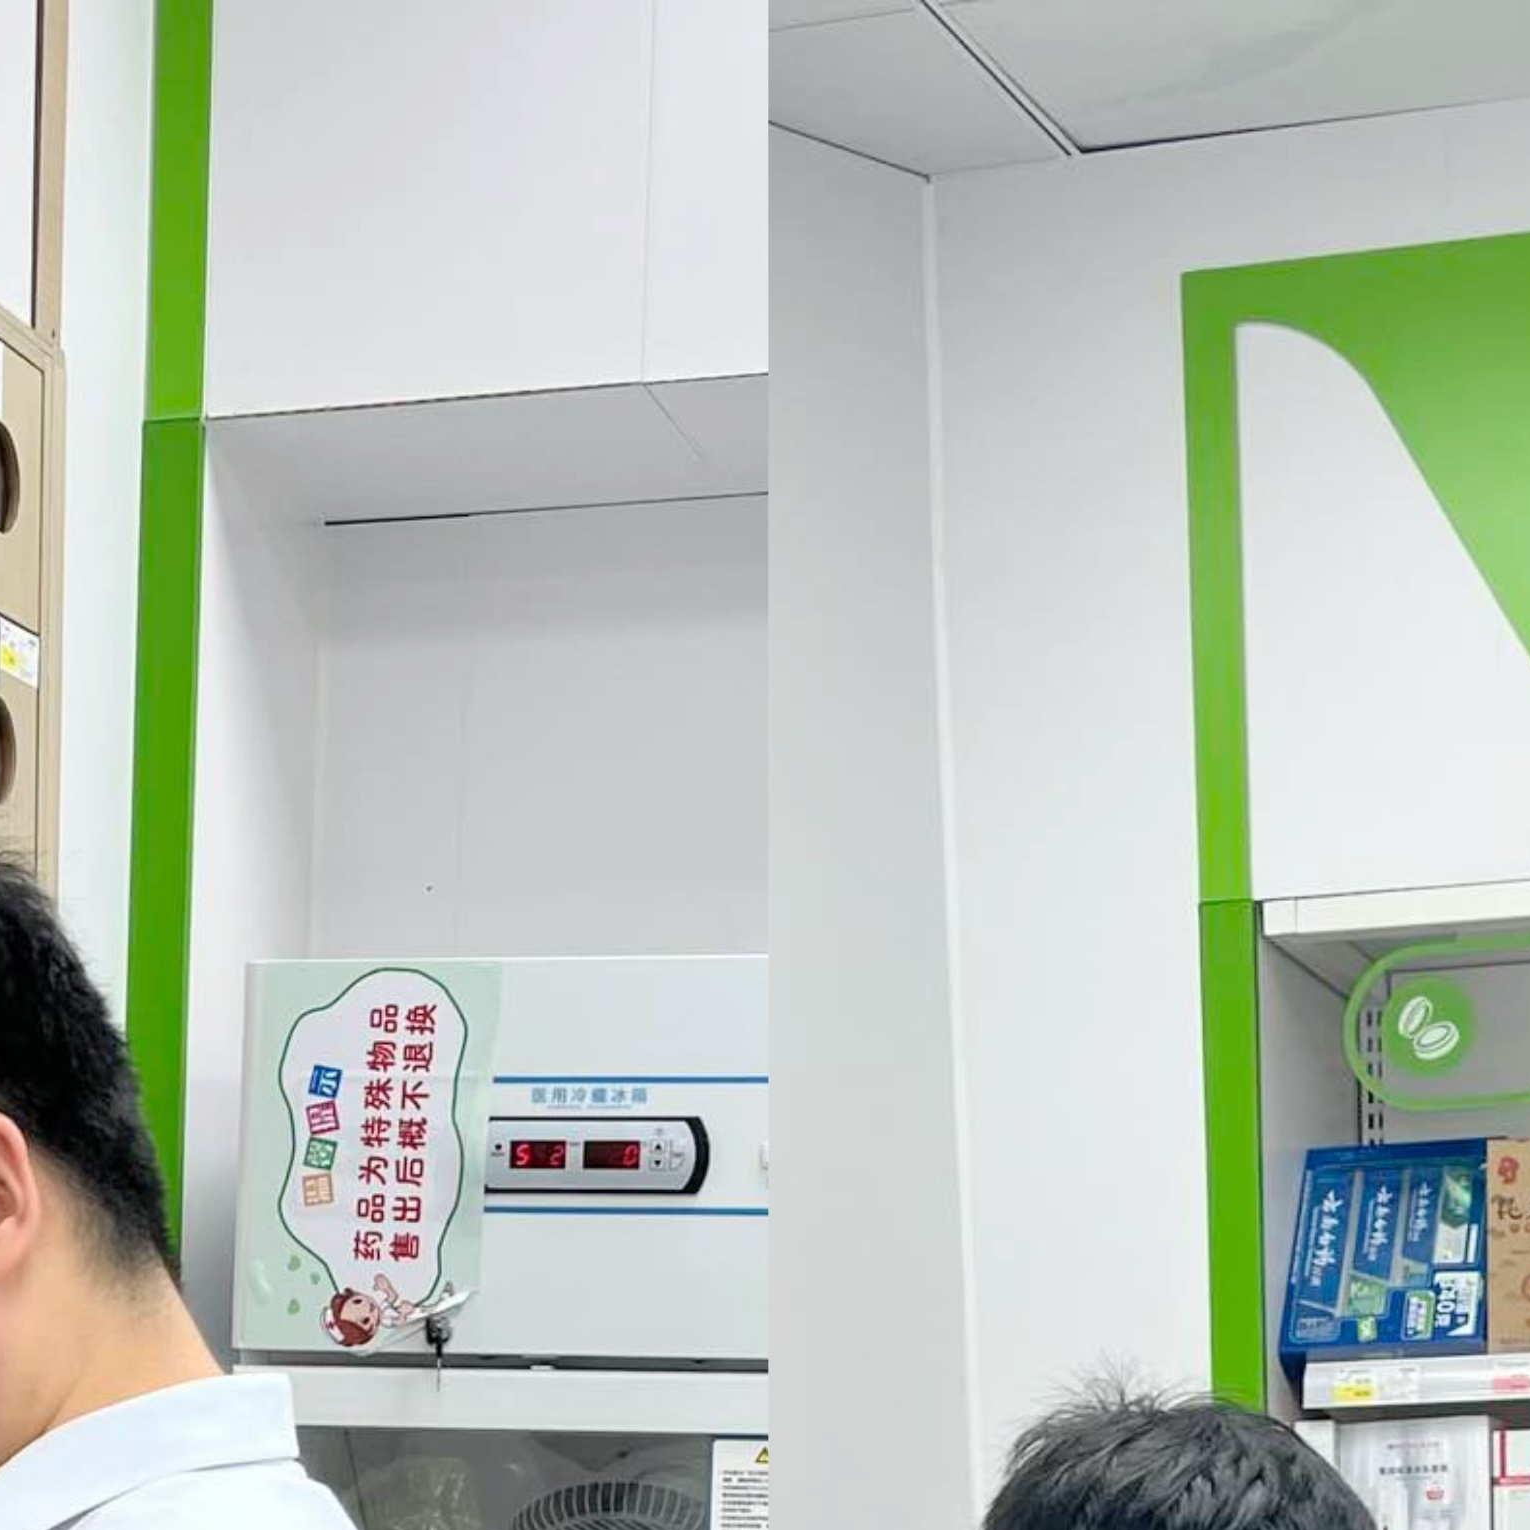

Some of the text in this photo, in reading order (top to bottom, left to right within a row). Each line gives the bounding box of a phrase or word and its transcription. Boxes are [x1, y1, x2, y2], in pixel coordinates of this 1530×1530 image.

[303, 1065, 343, 1206] 温馨提示
[354, 1004, 399, 1262] 药品为特殊物品
[389, 1003, 438, 1262] 售出后概不退换
